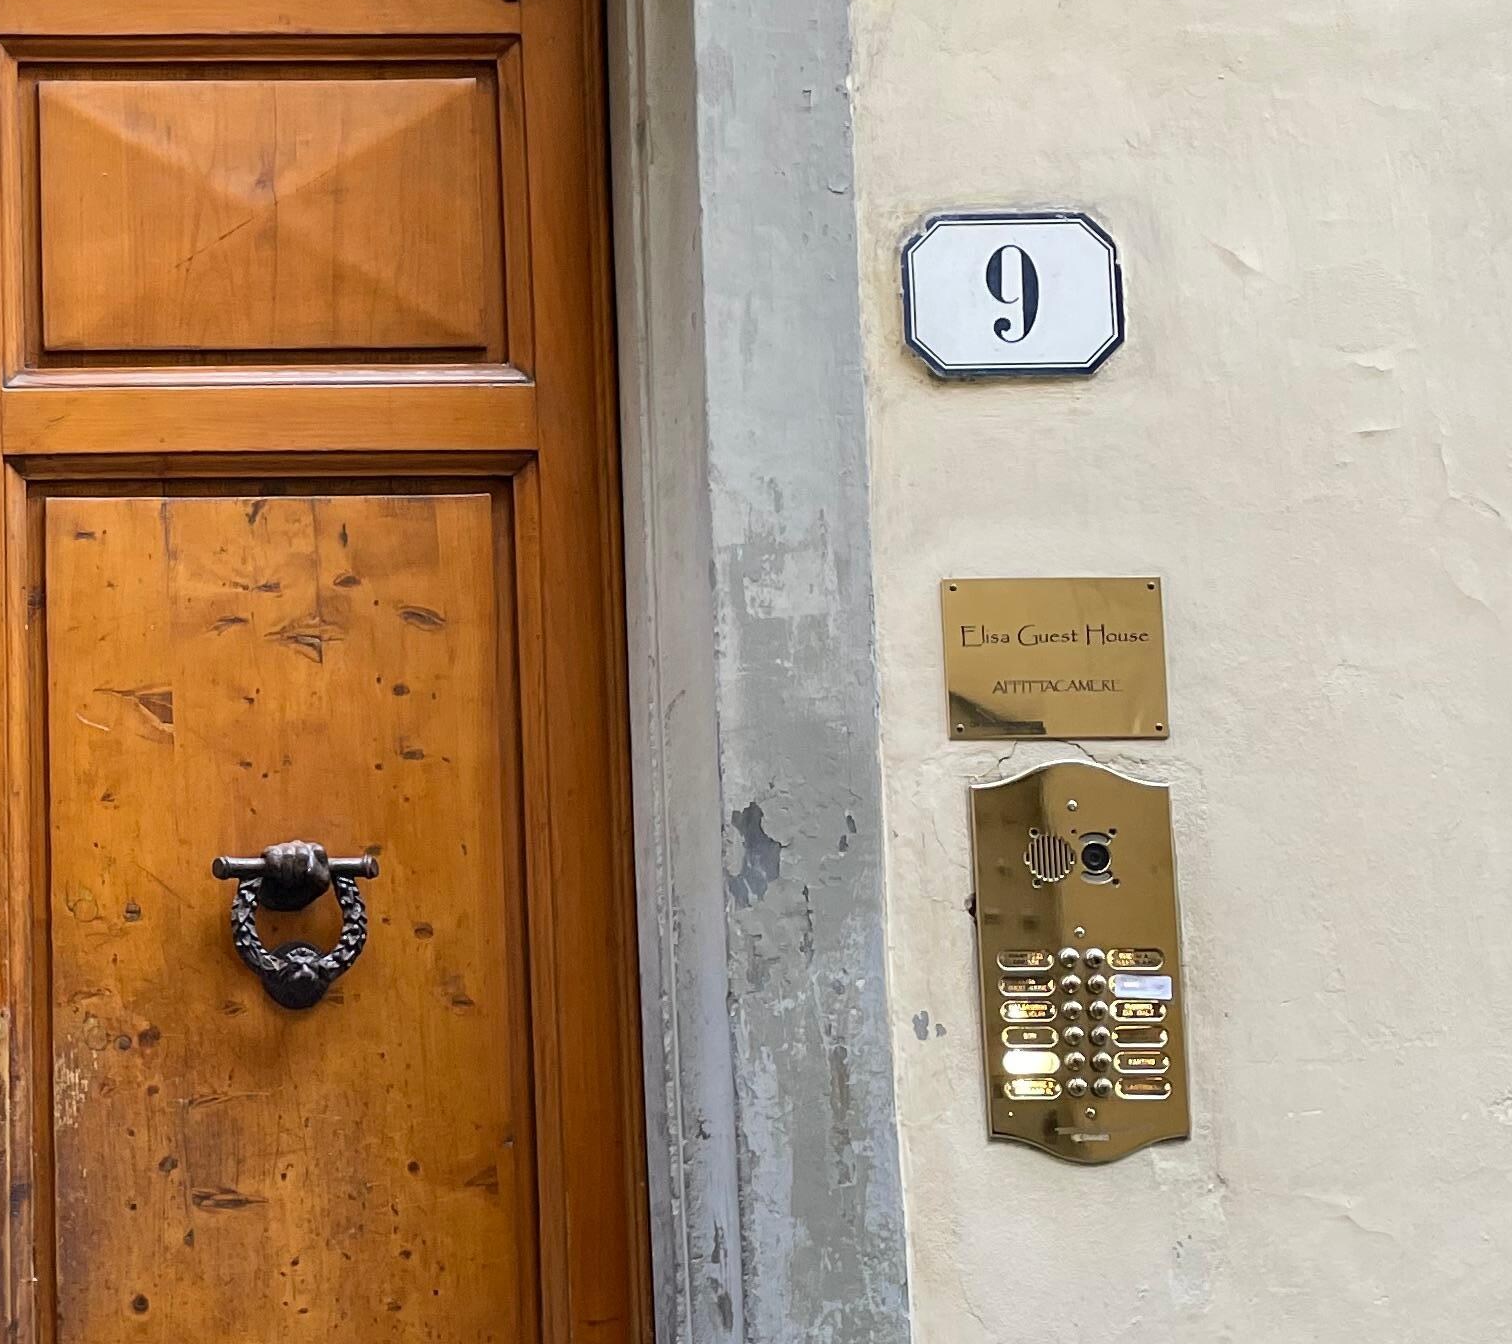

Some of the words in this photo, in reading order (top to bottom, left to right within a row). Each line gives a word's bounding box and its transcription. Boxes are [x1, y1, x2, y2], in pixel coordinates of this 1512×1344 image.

[986, 244, 1039, 343] 9
[960, 624, 1010, 647] Elisa
[1017, 624, 1078, 647] Guest
[1086, 623, 1150, 646] House
